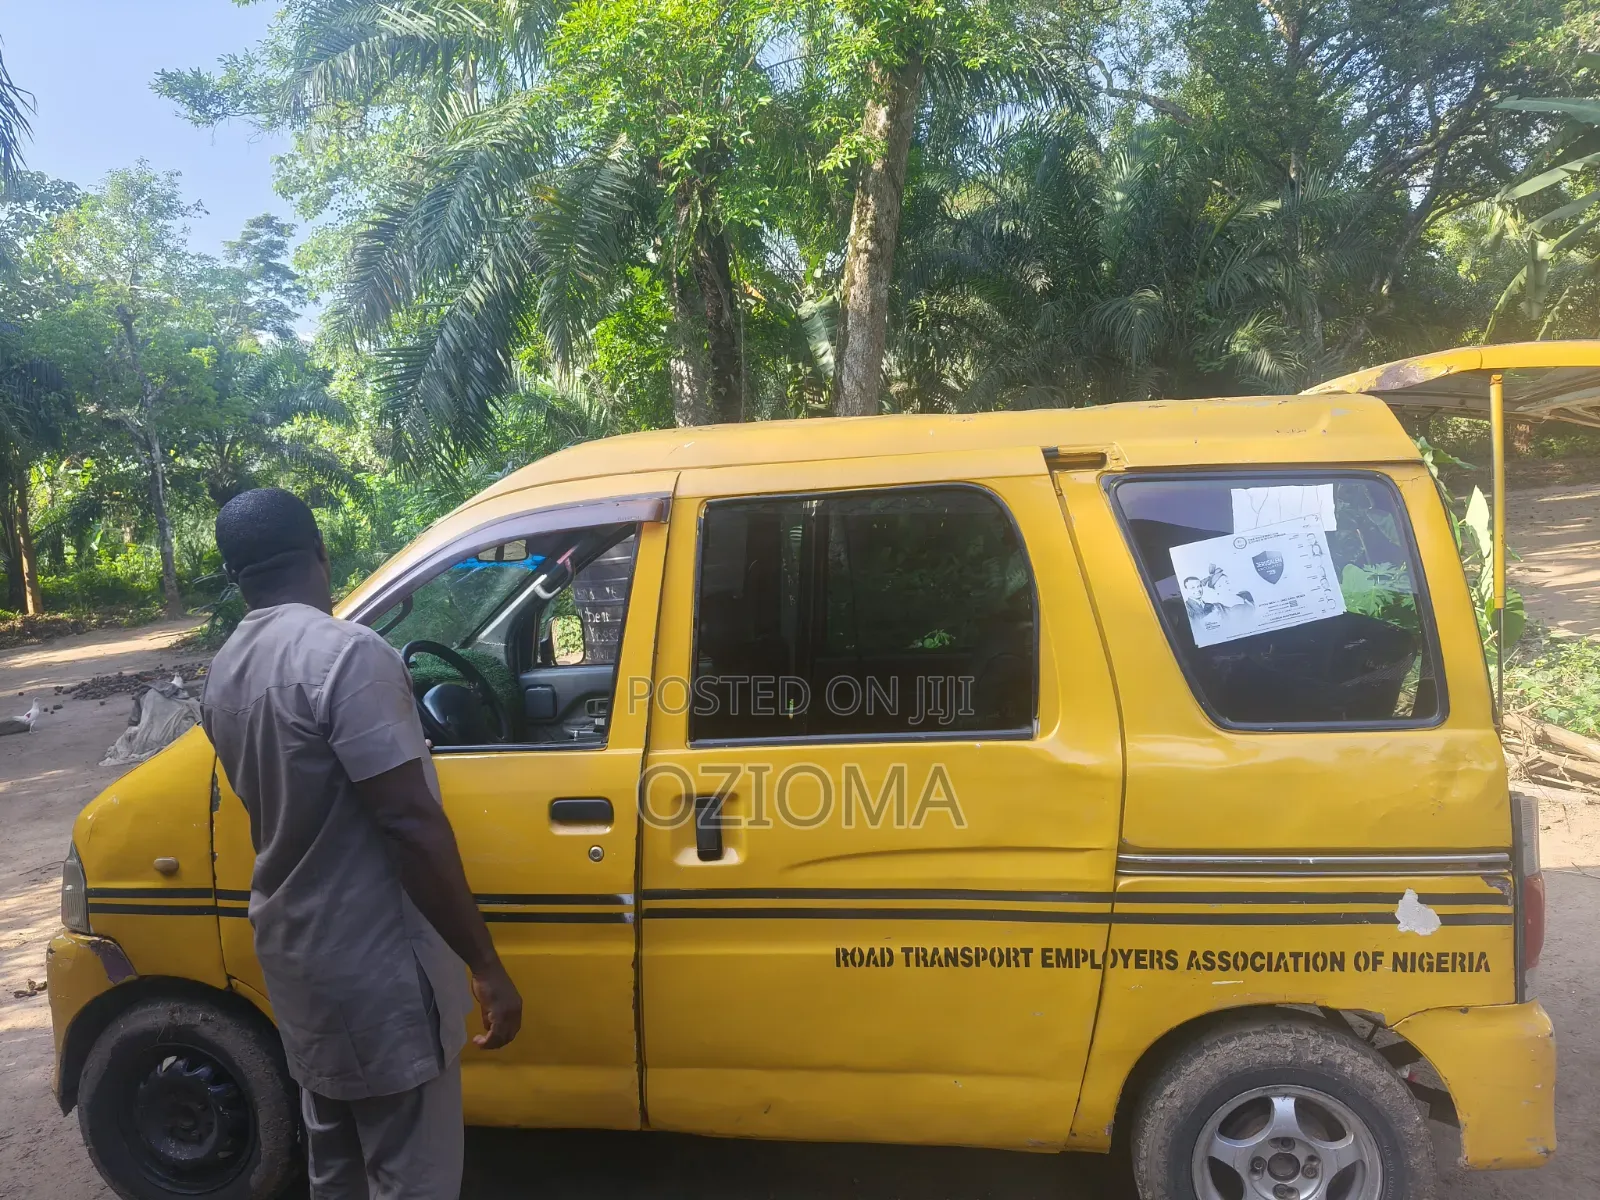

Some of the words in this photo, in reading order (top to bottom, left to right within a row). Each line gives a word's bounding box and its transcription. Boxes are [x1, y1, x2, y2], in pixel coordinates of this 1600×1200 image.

[835, 946, 895, 968] ROAD
[900, 946, 1034, 968] TRANSPORT
[1040, 947, 1179, 970] EMPLOYERS
[1186, 949, 1345, 973] ASSOCIATION
[1353, 950, 1385, 972] OF
[1391, 951, 1491, 973] NIGERIA
